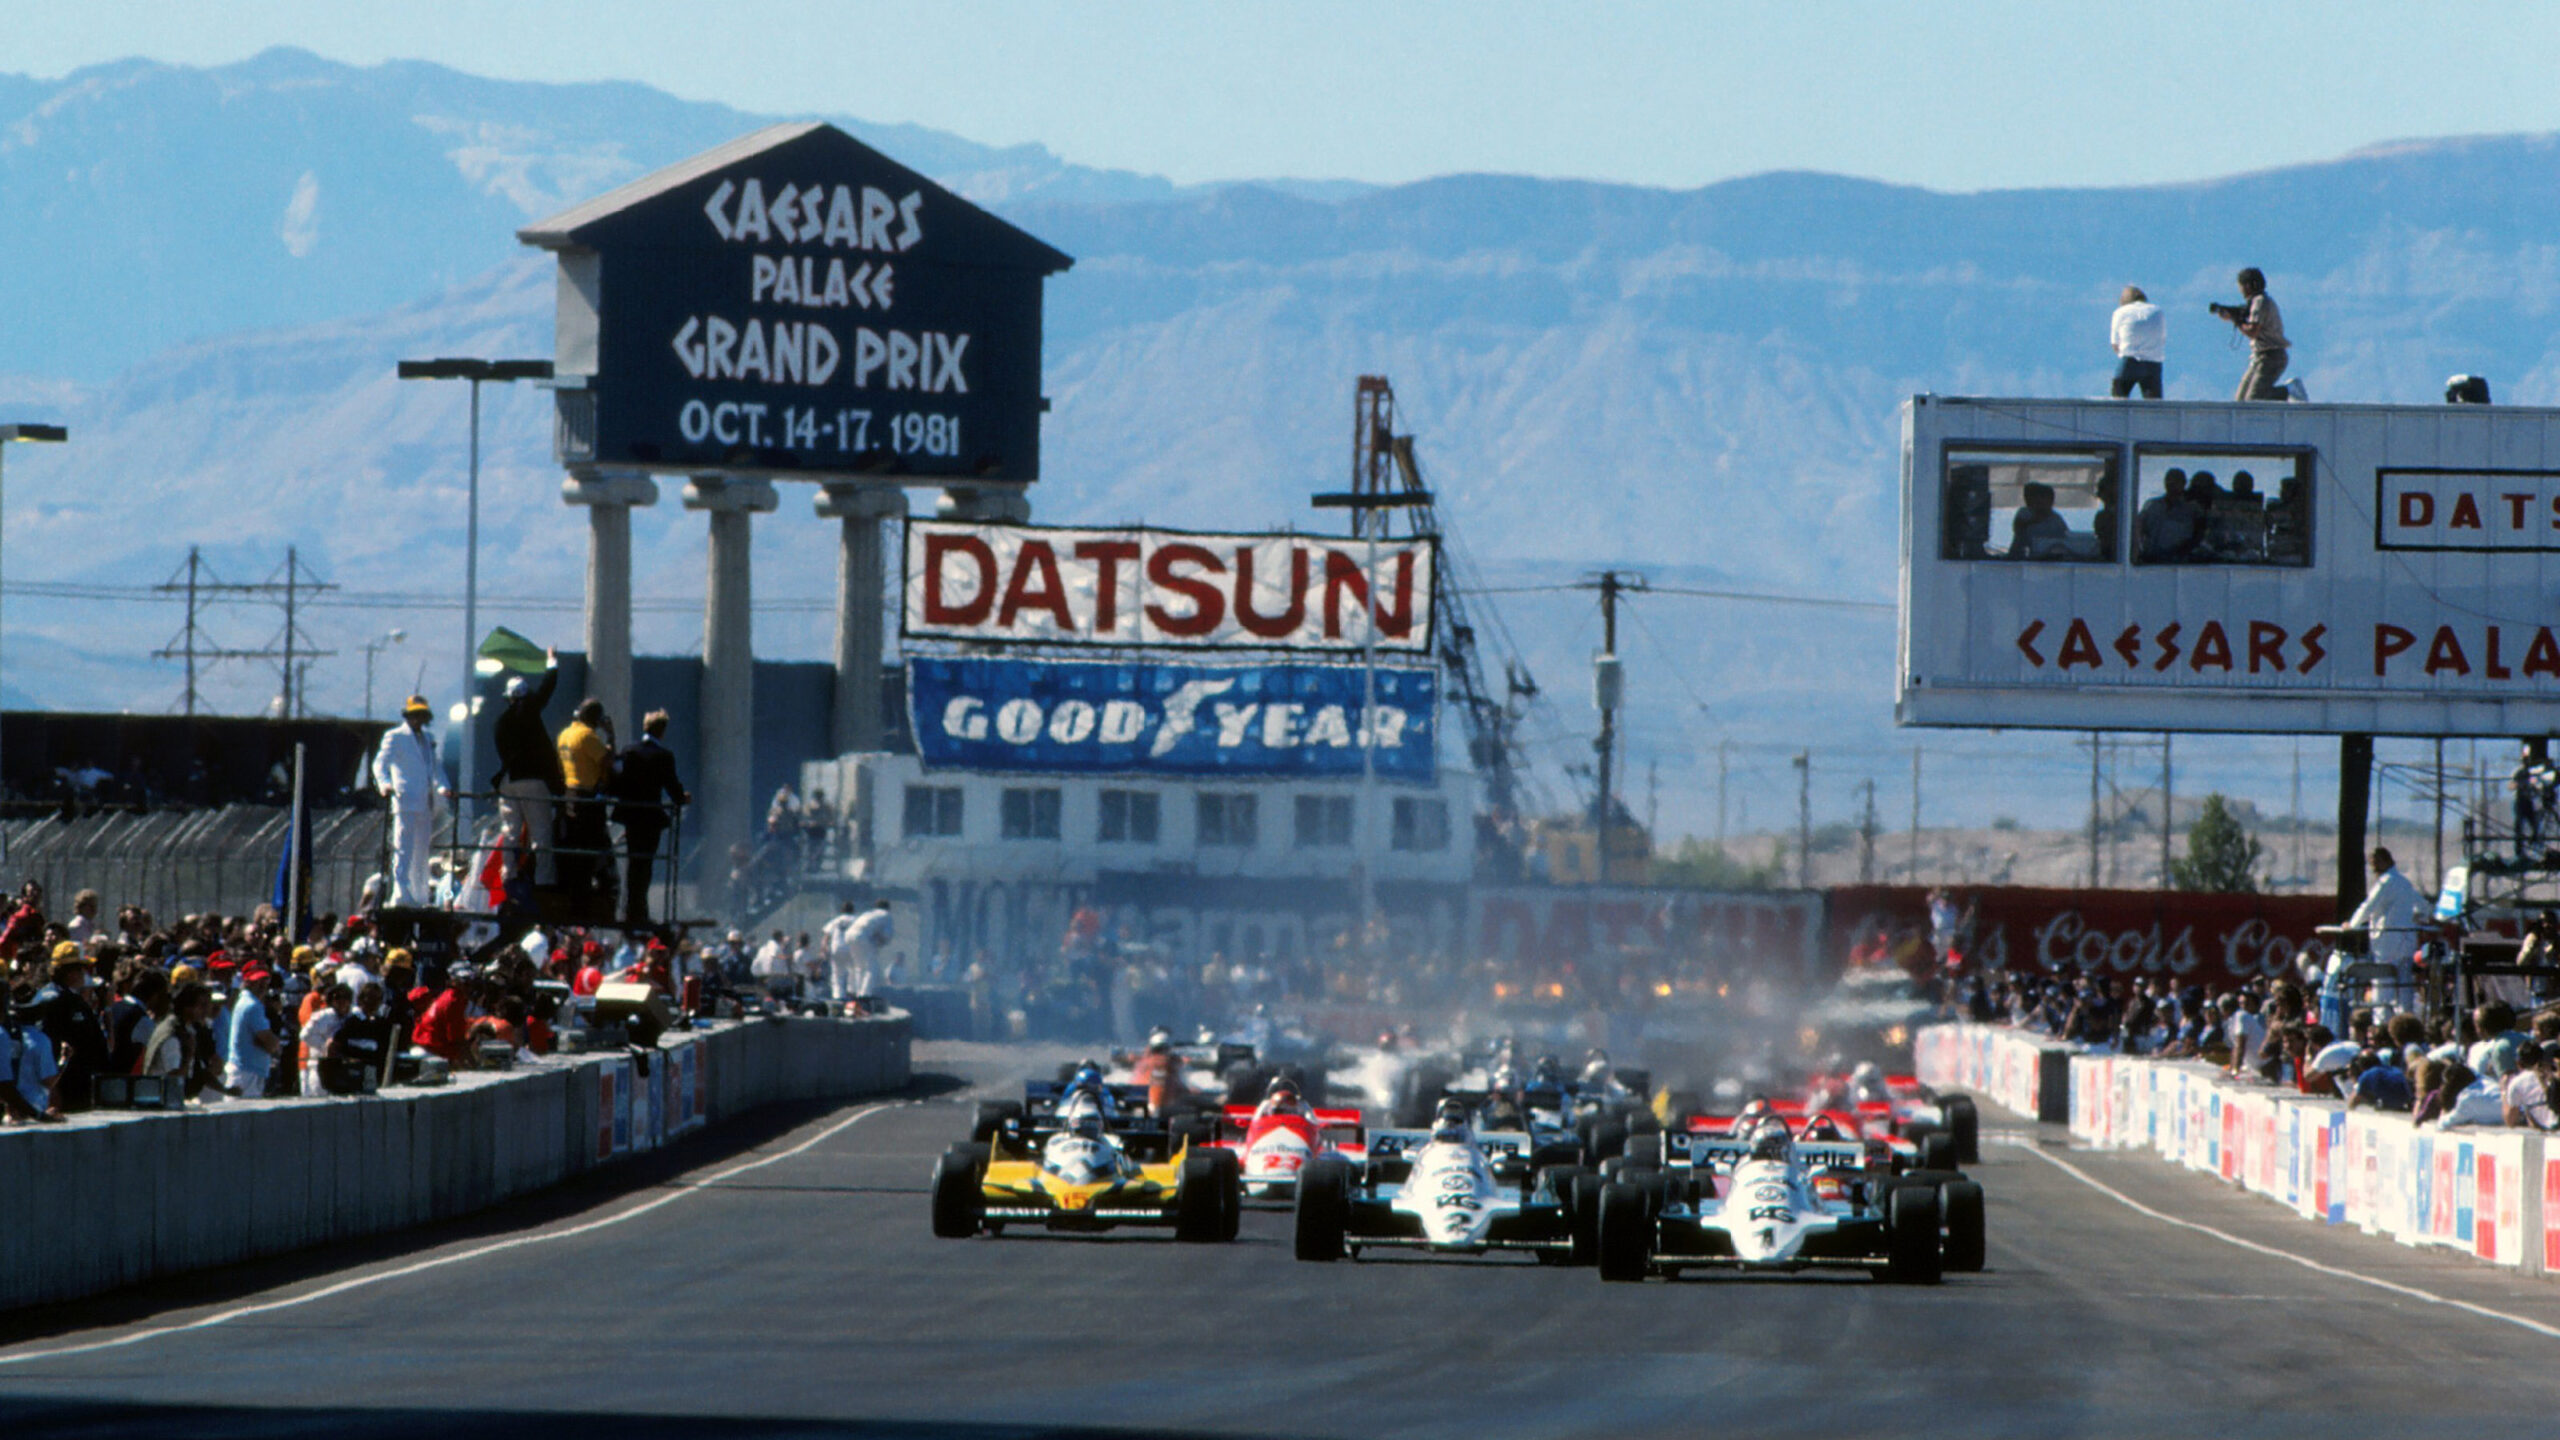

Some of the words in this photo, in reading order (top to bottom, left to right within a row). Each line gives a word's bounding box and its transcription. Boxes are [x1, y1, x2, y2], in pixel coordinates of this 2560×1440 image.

[704, 178, 923, 253] CAESARS
[752, 255, 893, 310] PALACE
[671, 315, 840, 386] GRAND
[854, 327, 970, 394] PRIX
[679, 399, 772, 445] OCT.
[891, 412, 960, 457] 1981
[924, 532, 1415, 640] DATSUN
[2017, 617, 2328, 675] CAESARS
[2374, 622, 2560, 680] PALA
[942, 695, 1146, 746] GOOD
[1214, 702, 1408, 749] YEAR
[2034, 910, 2198, 974] Coors
[2220, 918, 2340, 976] Coo
[1062, 1191, 1089, 1209] 15
[1444, 1211, 1474, 1234] 2
[1753, 1226, 1775, 1250] 1
